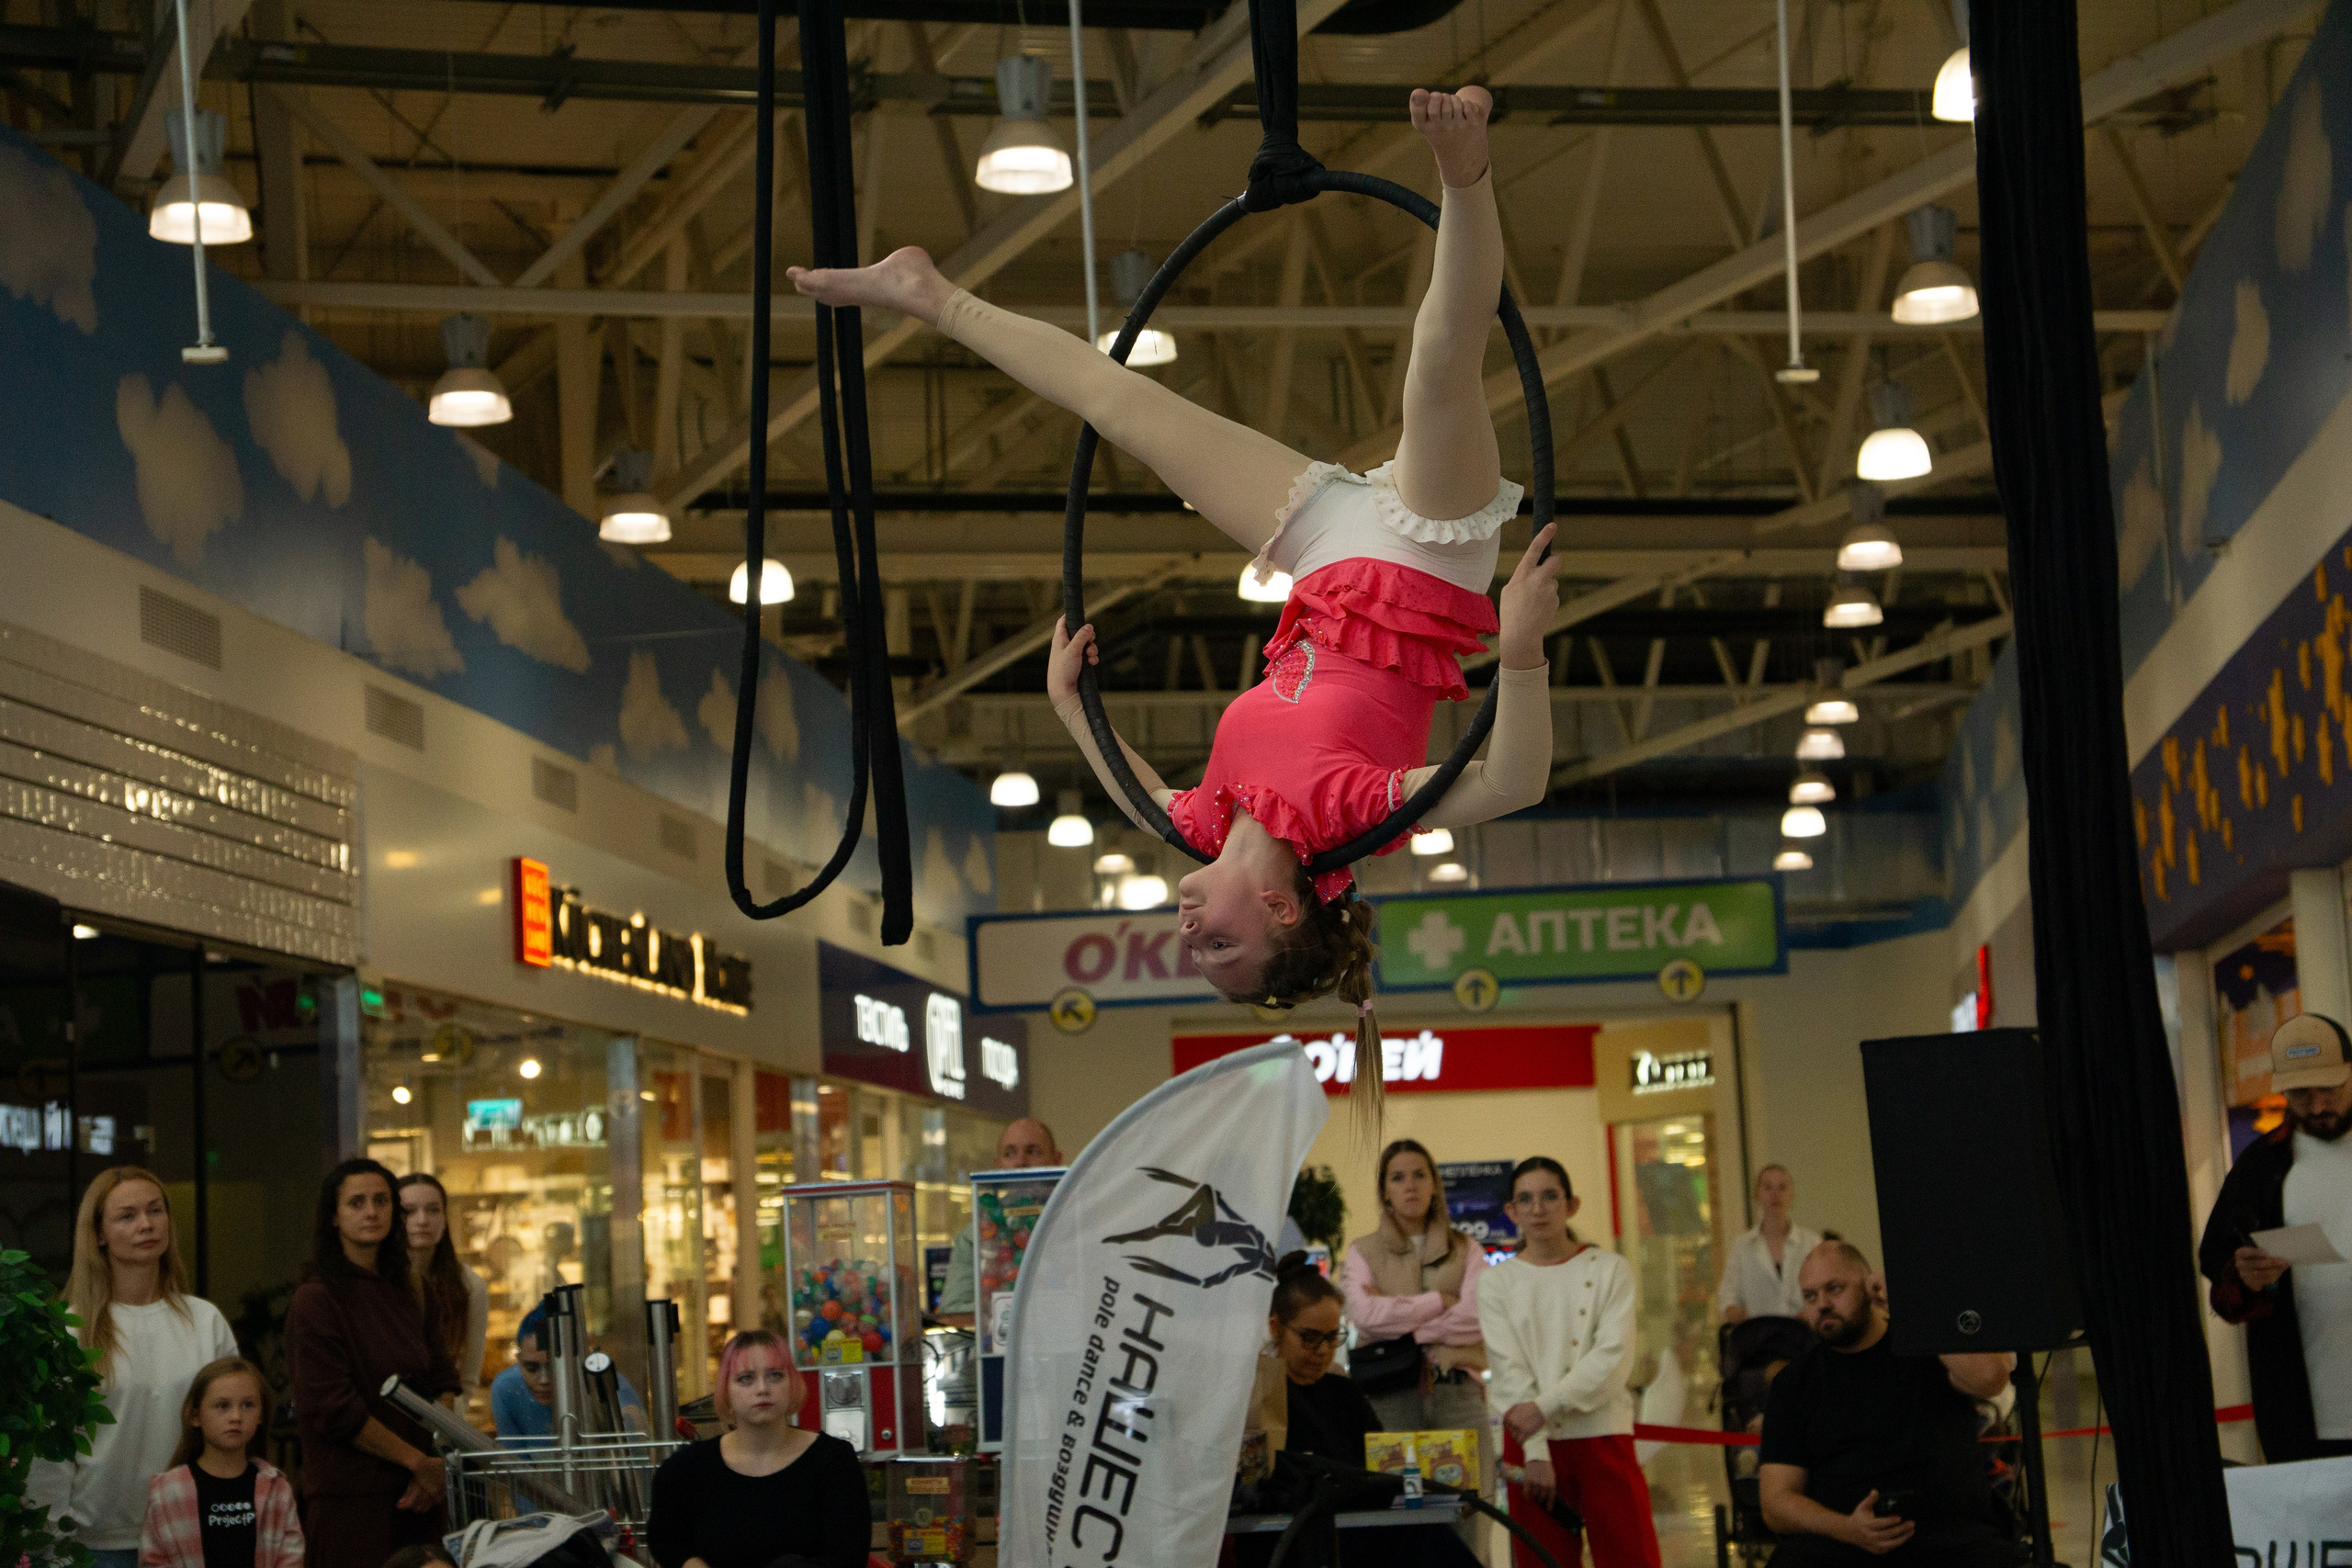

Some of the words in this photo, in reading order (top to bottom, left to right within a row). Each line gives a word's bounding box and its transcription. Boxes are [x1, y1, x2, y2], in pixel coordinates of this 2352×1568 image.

[1486, 902, 1723, 955] АПТЕКА
[1094, 1275, 1120, 1328] pole
[1073, 1334, 1105, 1405] dance
[1063, 1292, 1175, 1568] НАШЕС
[1067, 1410, 1085, 1427] &
[1046, 1434, 1077, 1556] воздушн
